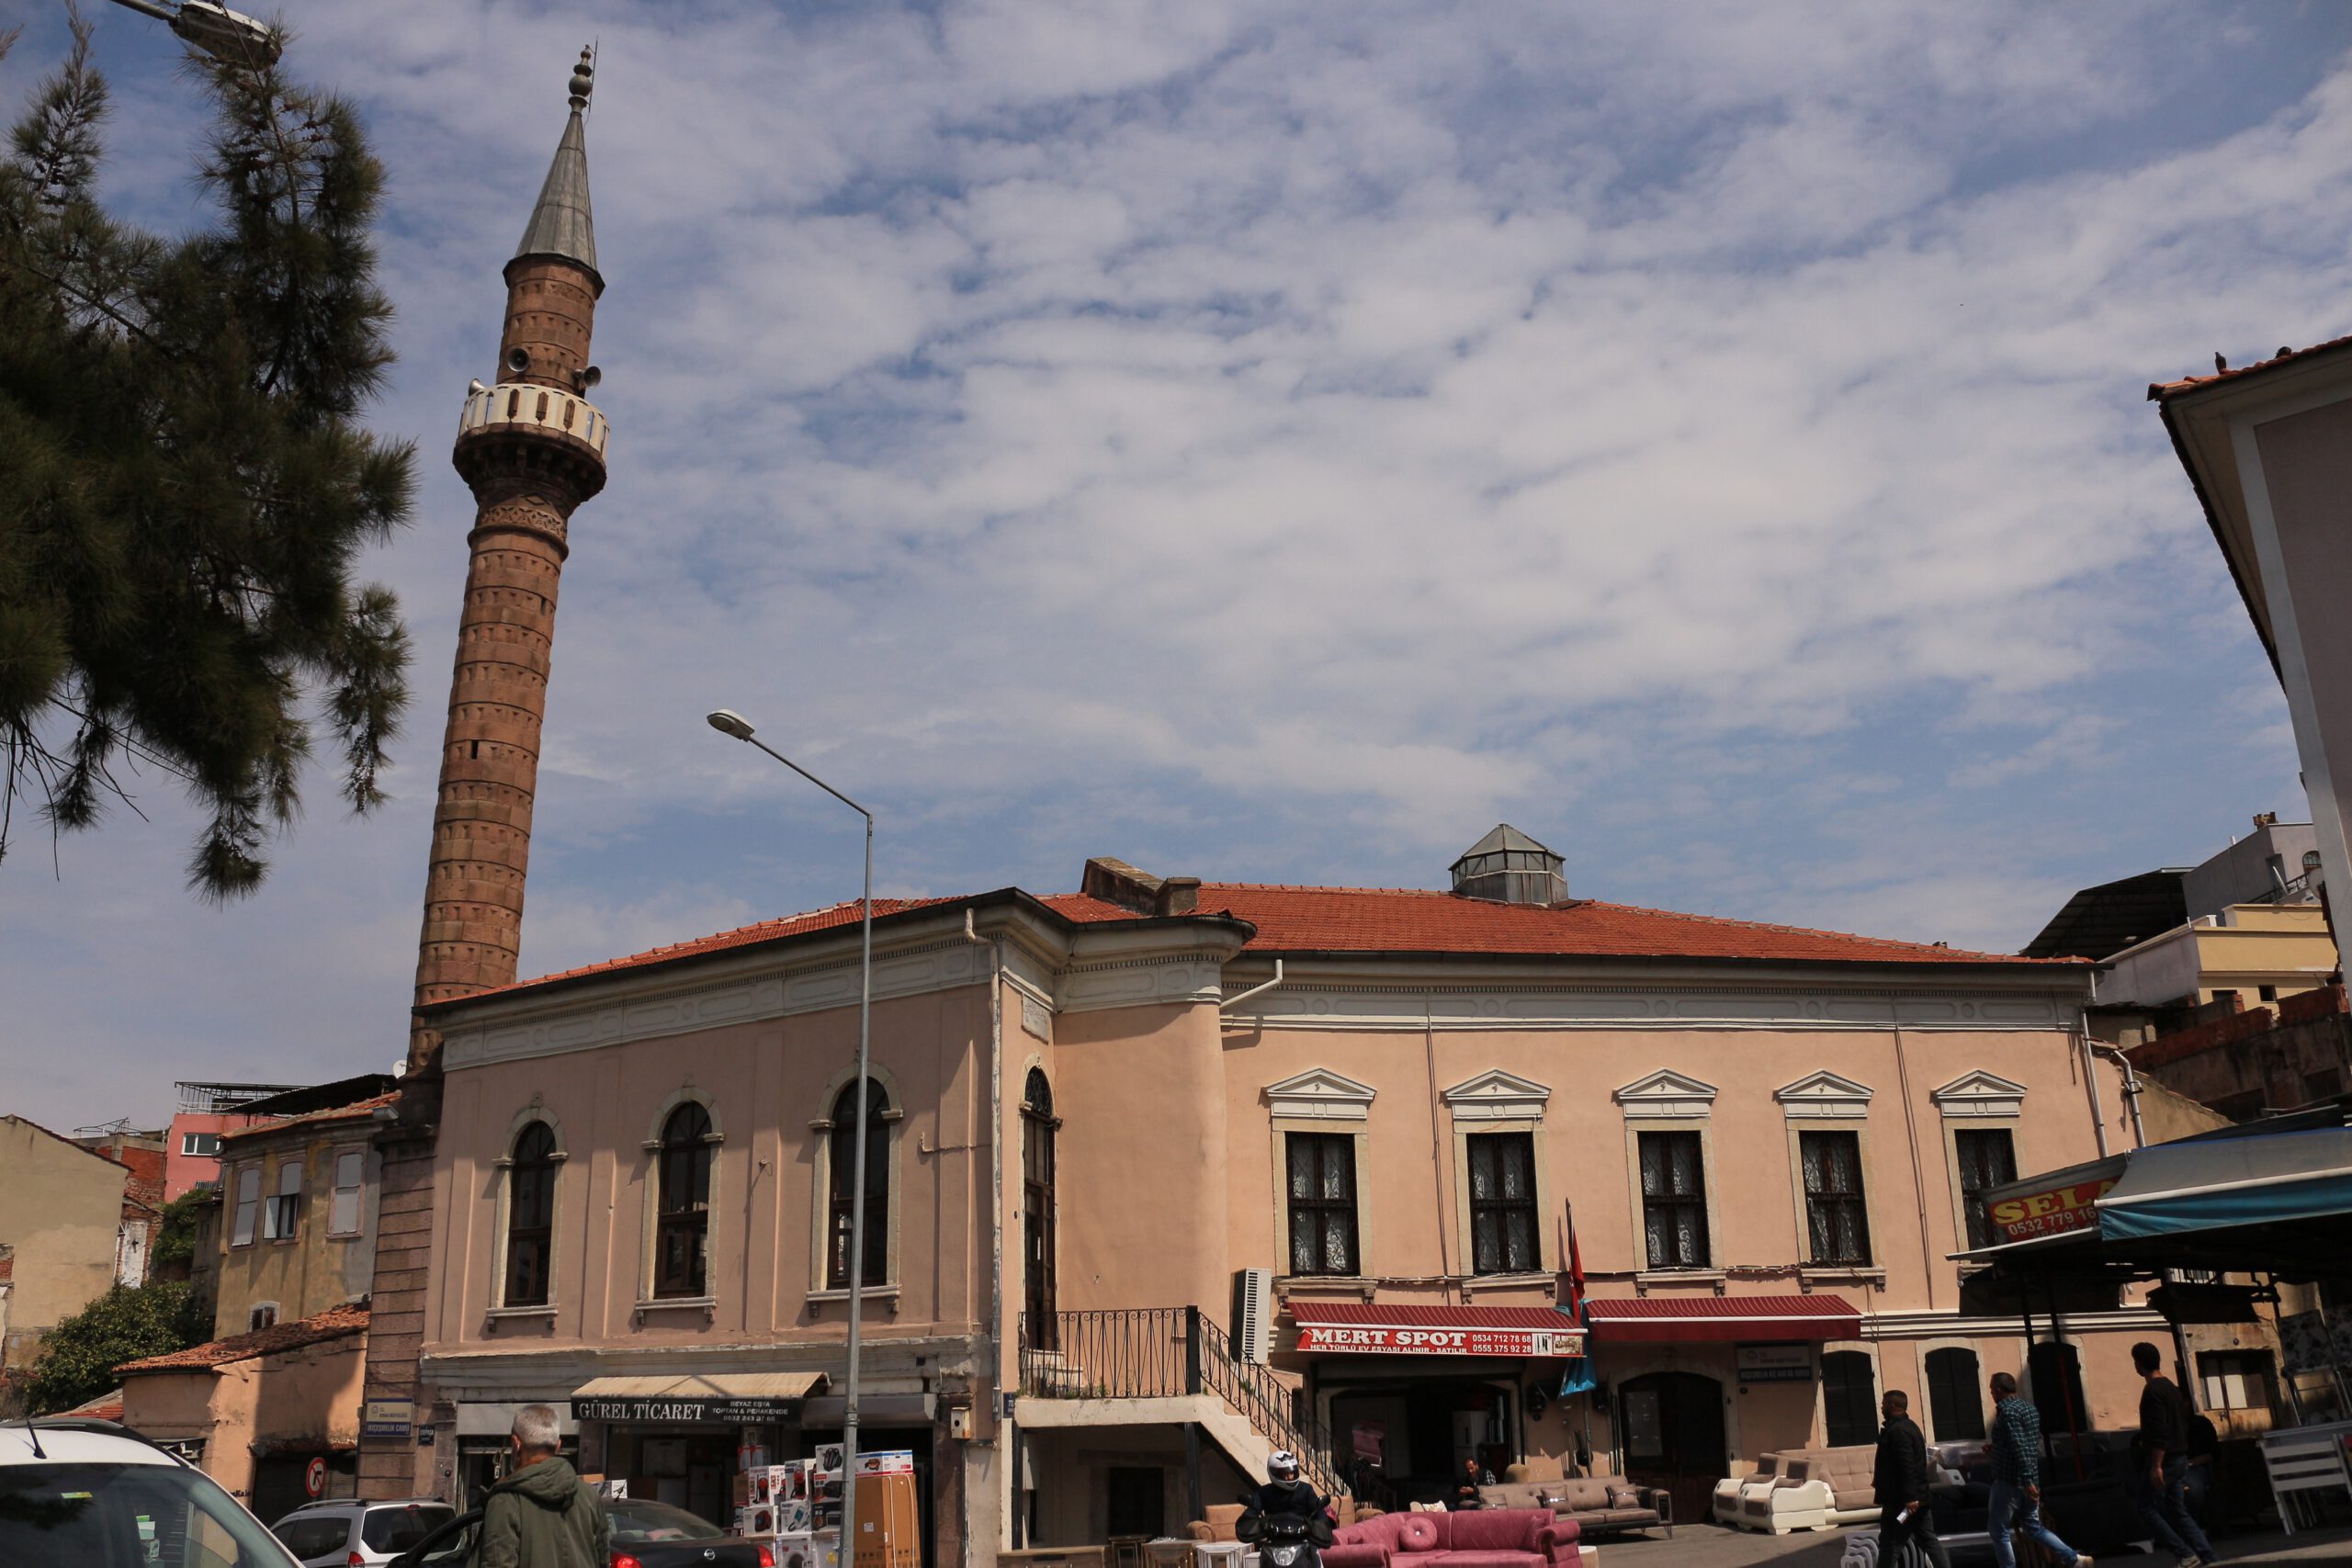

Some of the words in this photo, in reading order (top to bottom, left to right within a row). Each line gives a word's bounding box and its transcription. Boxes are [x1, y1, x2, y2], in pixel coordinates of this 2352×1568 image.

[2008, 1218, 2044, 1235] 0532
[2047, 1212, 2074, 1226] 779
[2078, 1206, 2097, 1220] 16
[1310, 1328, 1388, 1345] MERT
[1396, 1331, 1467, 1347] SPOT
[1472, 1334, 1492, 1342] 0534
[1494, 1335, 1509, 1343] 712
[1510, 1335, 1521, 1343] 78
[1521, 1335, 1532, 1343] 68
[1472, 1344, 1492, 1352] 0555
[1494, 1345, 1509, 1353] 375
[1510, 1345, 1521, 1353] 92
[1521, 1345, 1532, 1353] 28
[578, 1399, 631, 1419] GÜREL
[633, 1399, 706, 1420] TİCARET
